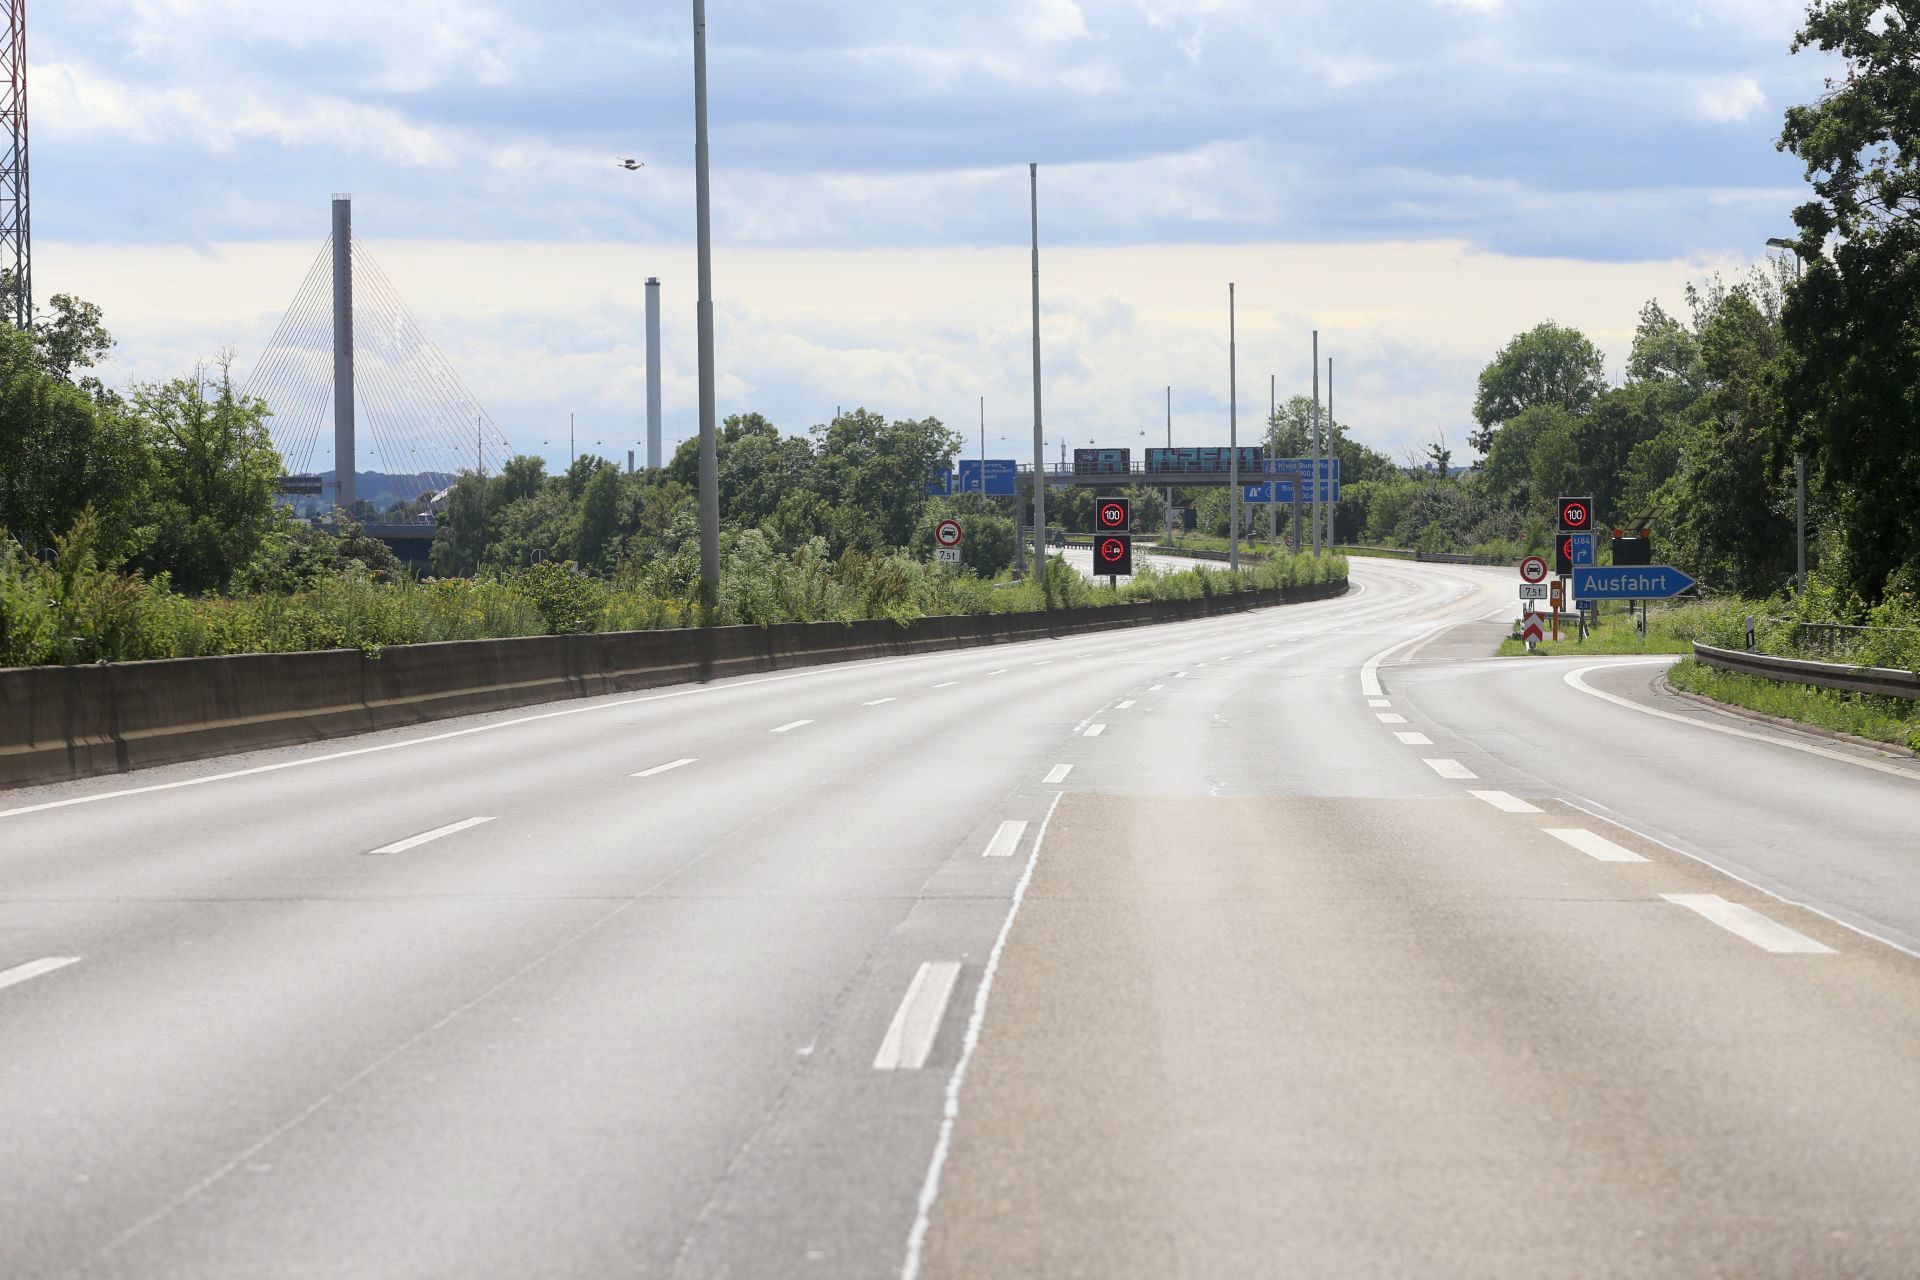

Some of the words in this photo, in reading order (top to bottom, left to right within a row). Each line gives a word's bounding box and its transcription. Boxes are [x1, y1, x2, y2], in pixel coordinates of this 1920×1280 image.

[1105, 510, 1120, 520] 100
[1567, 509, 1582, 520] 100
[1583, 575, 1667, 592] Ausfahrt
